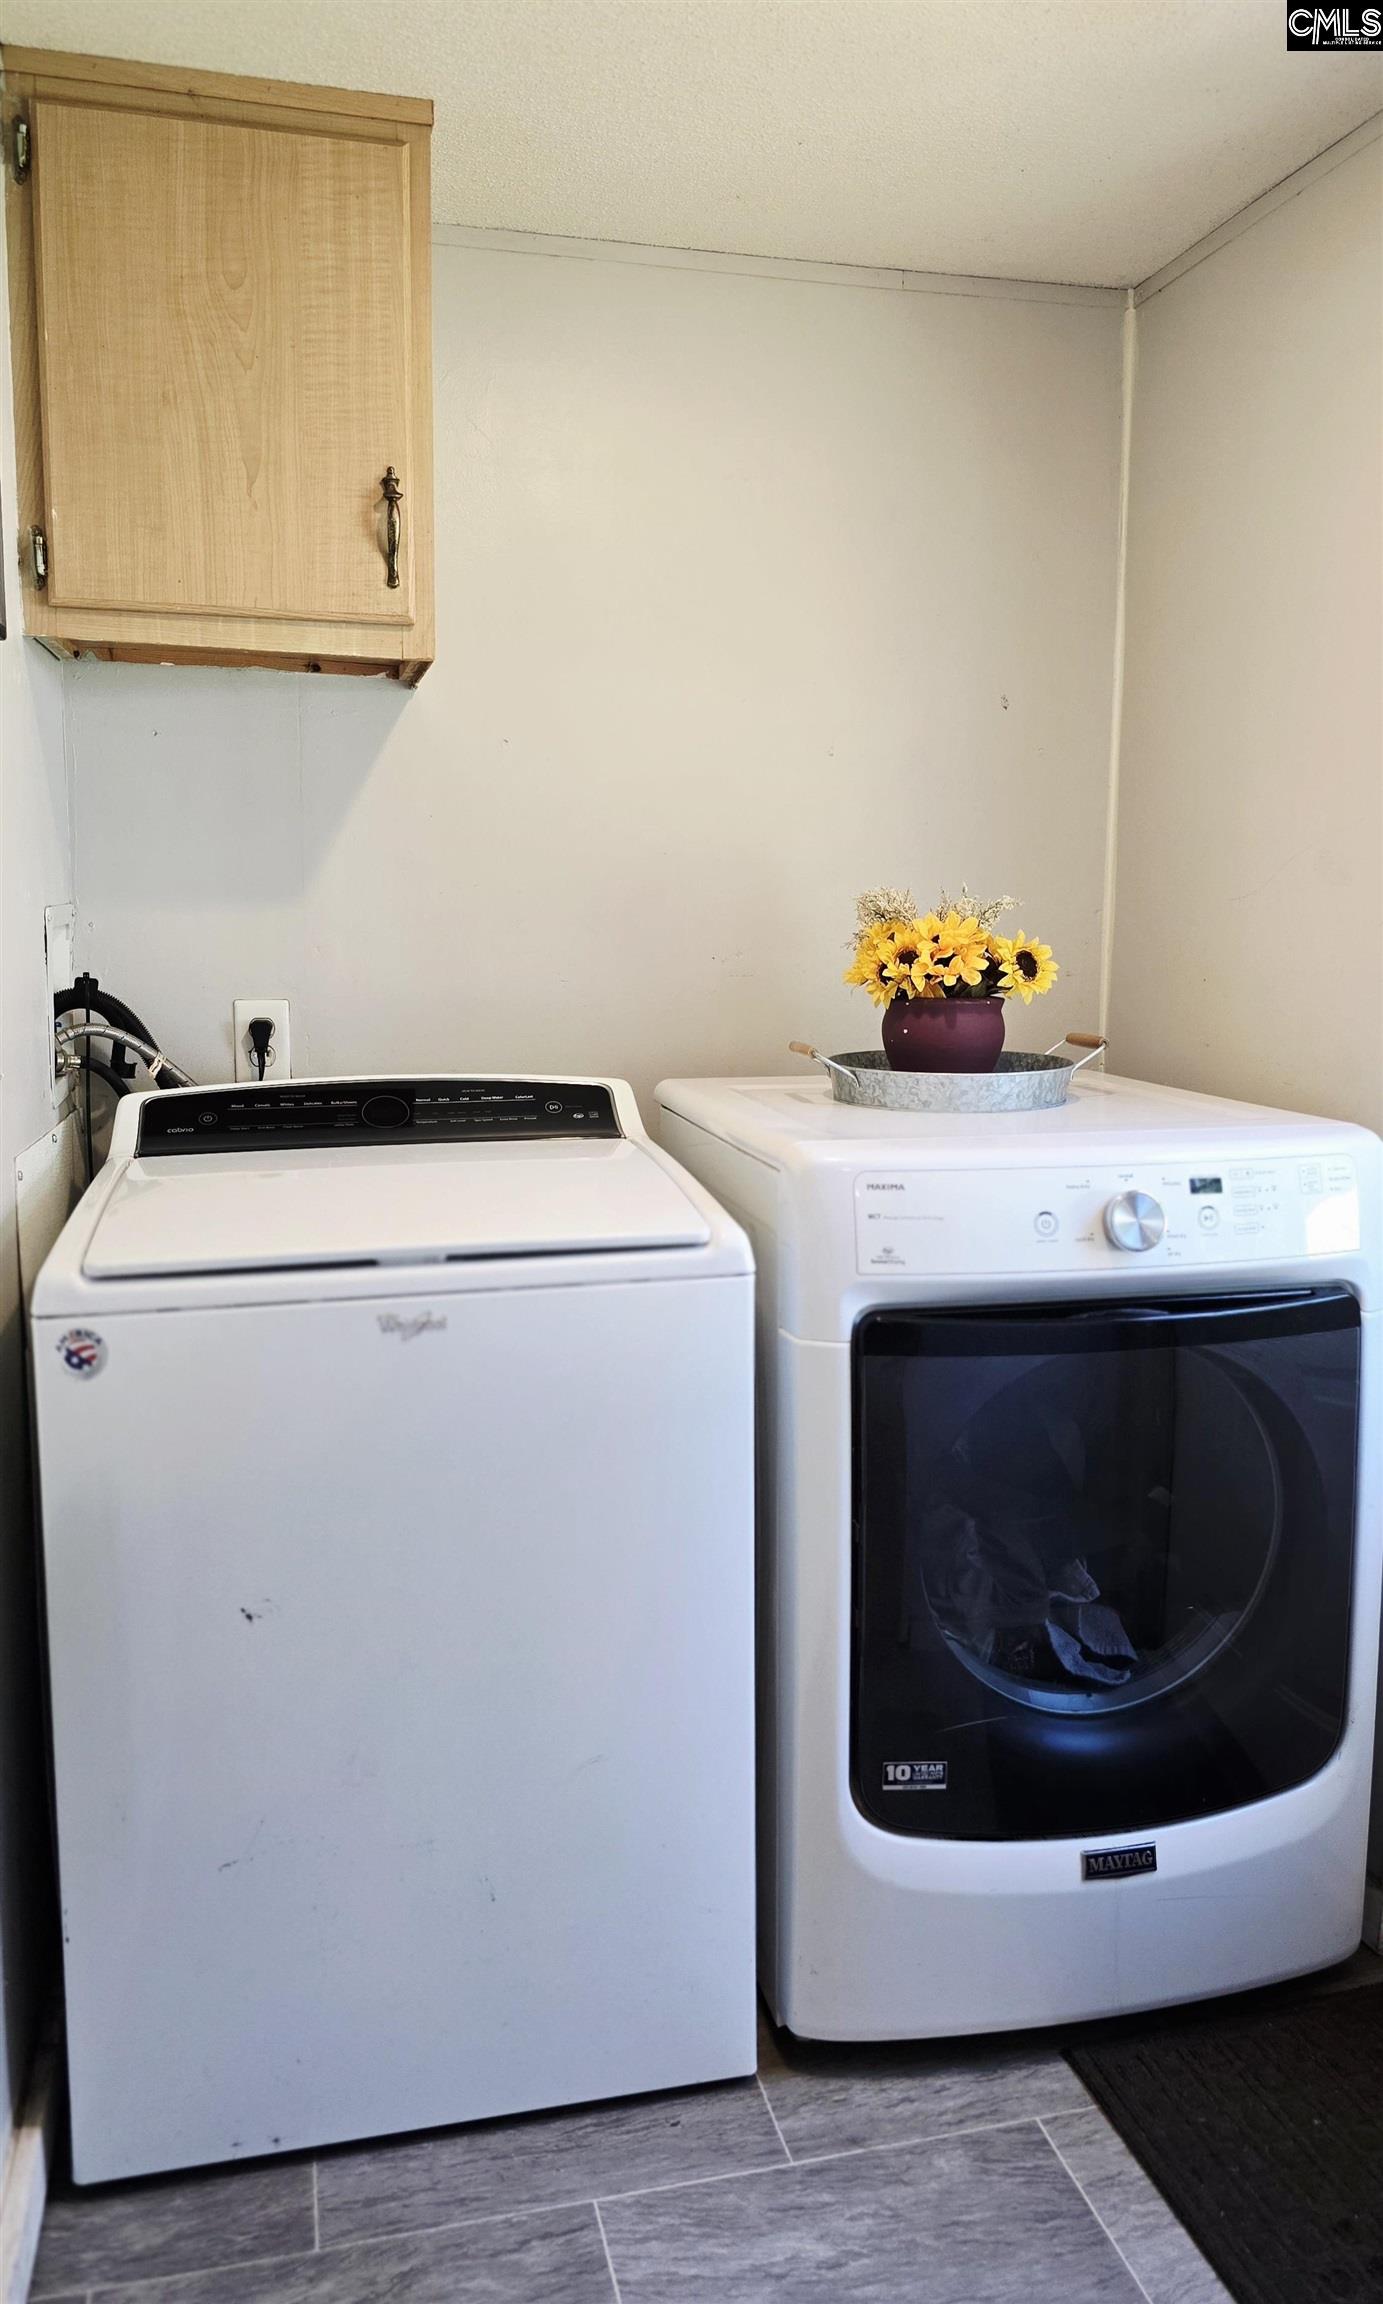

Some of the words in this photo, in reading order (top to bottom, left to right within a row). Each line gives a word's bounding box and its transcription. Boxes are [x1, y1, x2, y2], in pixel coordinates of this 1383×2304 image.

[866, 1183, 906, 1191] MAXIMA
[886, 1764, 912, 1782] 10
[1088, 1850, 1153, 1873] MAYTAG
